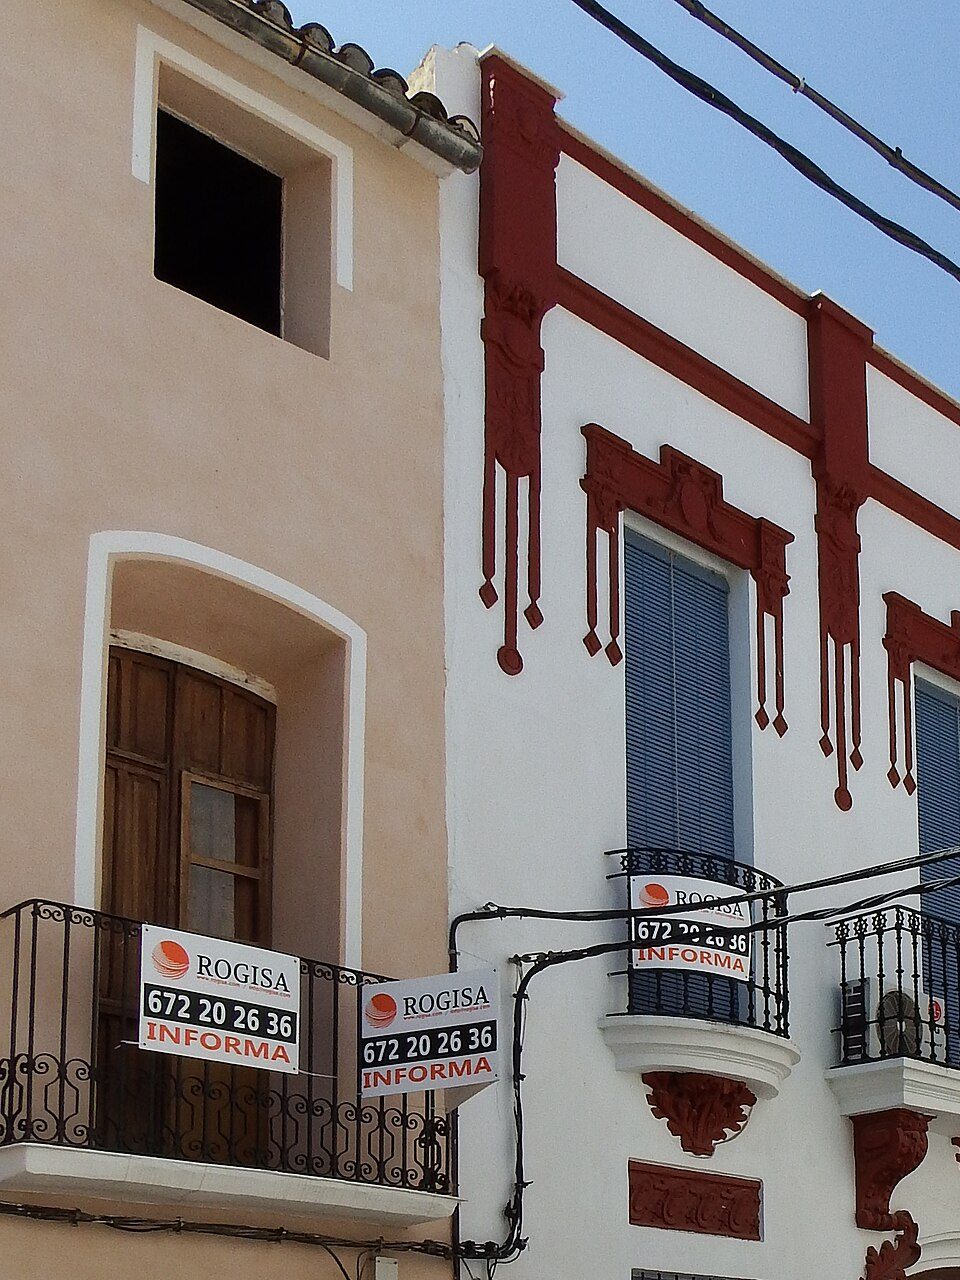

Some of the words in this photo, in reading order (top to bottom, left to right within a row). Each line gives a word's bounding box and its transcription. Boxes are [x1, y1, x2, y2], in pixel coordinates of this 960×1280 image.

[638, 922, 672, 940] 672
[197, 955, 290, 992] ROGISA
[638, 946, 744, 973] INFORMA
[148, 990, 191, 1019] 672
[199, 999, 226, 1025] 20
[233, 1006, 260, 1031] 26
[266, 1012, 292, 1037] 36
[403, 986, 489, 1016] ROGISA
[147, 1022, 290, 1063] INFORMA
[364, 1039, 399, 1063] 672
[407, 1035, 430, 1057] 20
[438, 1031, 461, 1053] 26
[469, 1026, 492, 1049] 36
[363, 1057, 492, 1088] INFORMA
